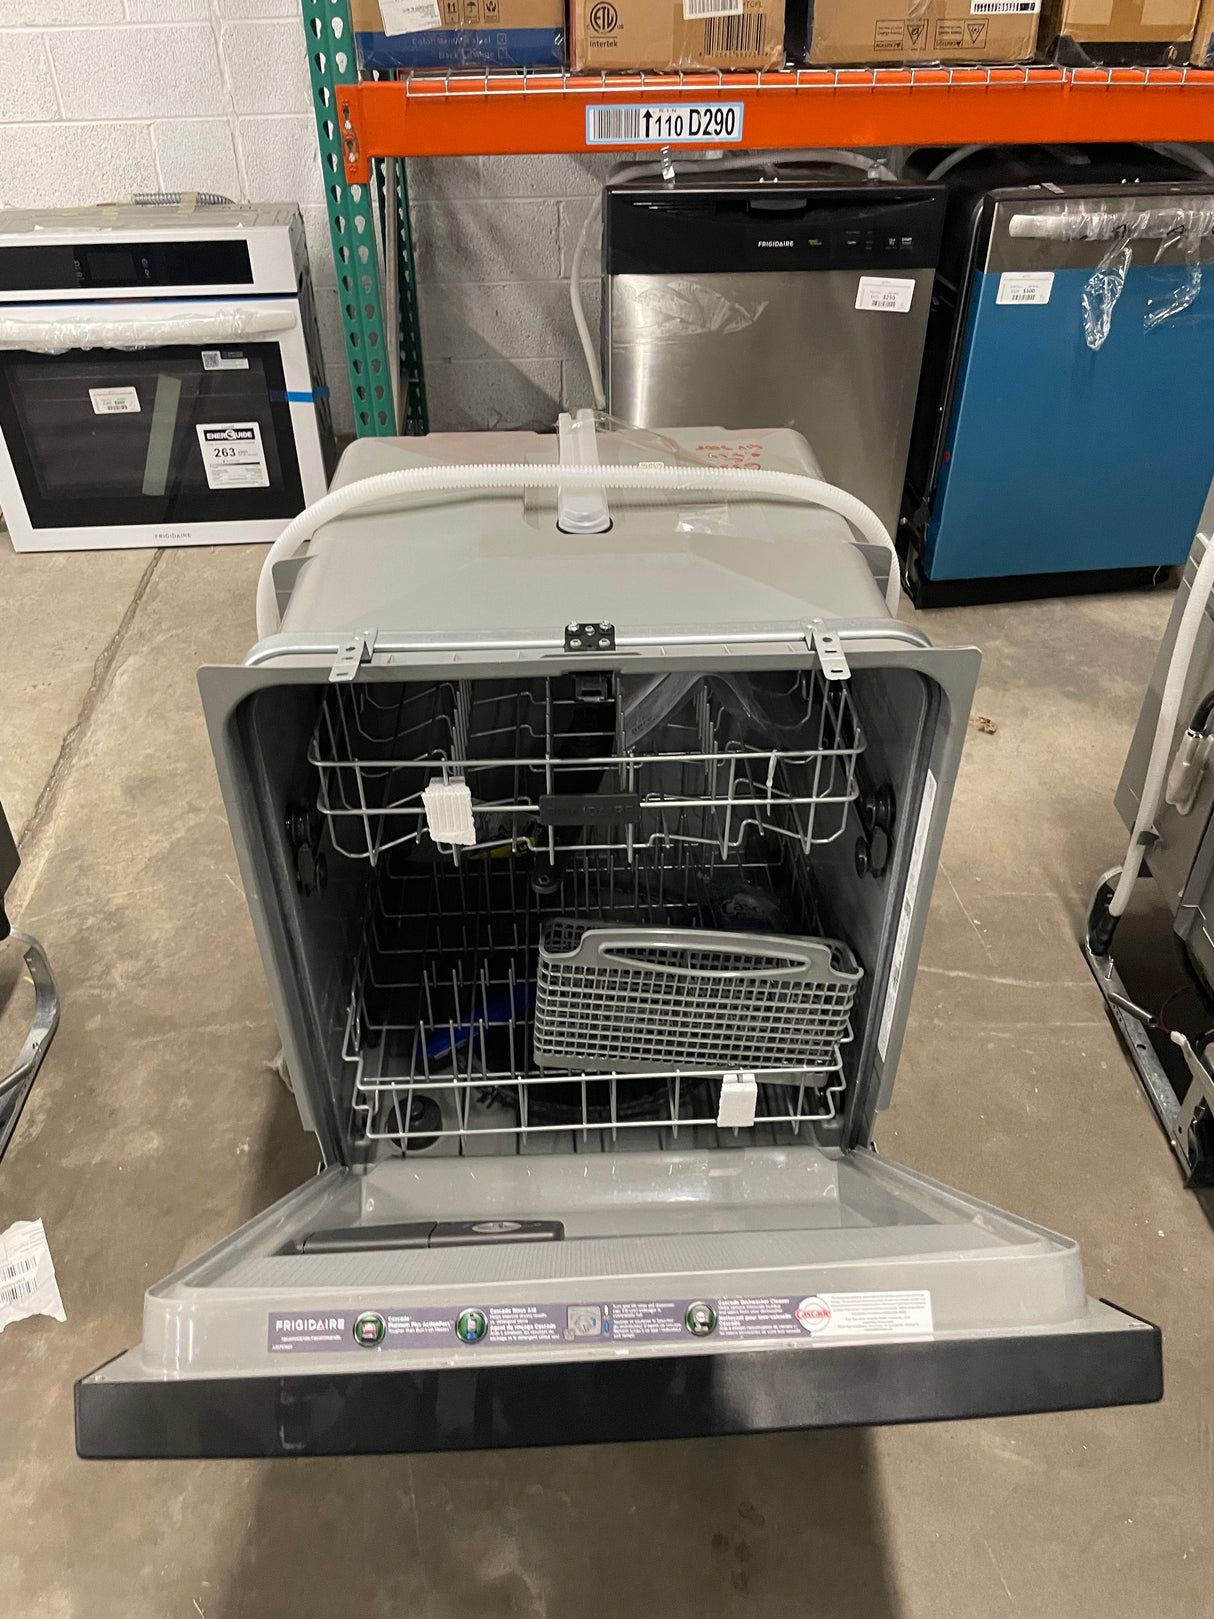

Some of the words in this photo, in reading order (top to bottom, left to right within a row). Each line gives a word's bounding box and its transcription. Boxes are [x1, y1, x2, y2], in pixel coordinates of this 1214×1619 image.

[589, 39, 618, 48] Intertek
[655, 115, 683, 137] 110
[688, 107, 736, 137] D290
[757, 239, 795, 248] FRIGIDAIRE
[213, 447, 236, 458] 263
[794, 1308, 831, 1320] Cascade
[275, 1318, 345, 1332] FRIGIDAIRE
